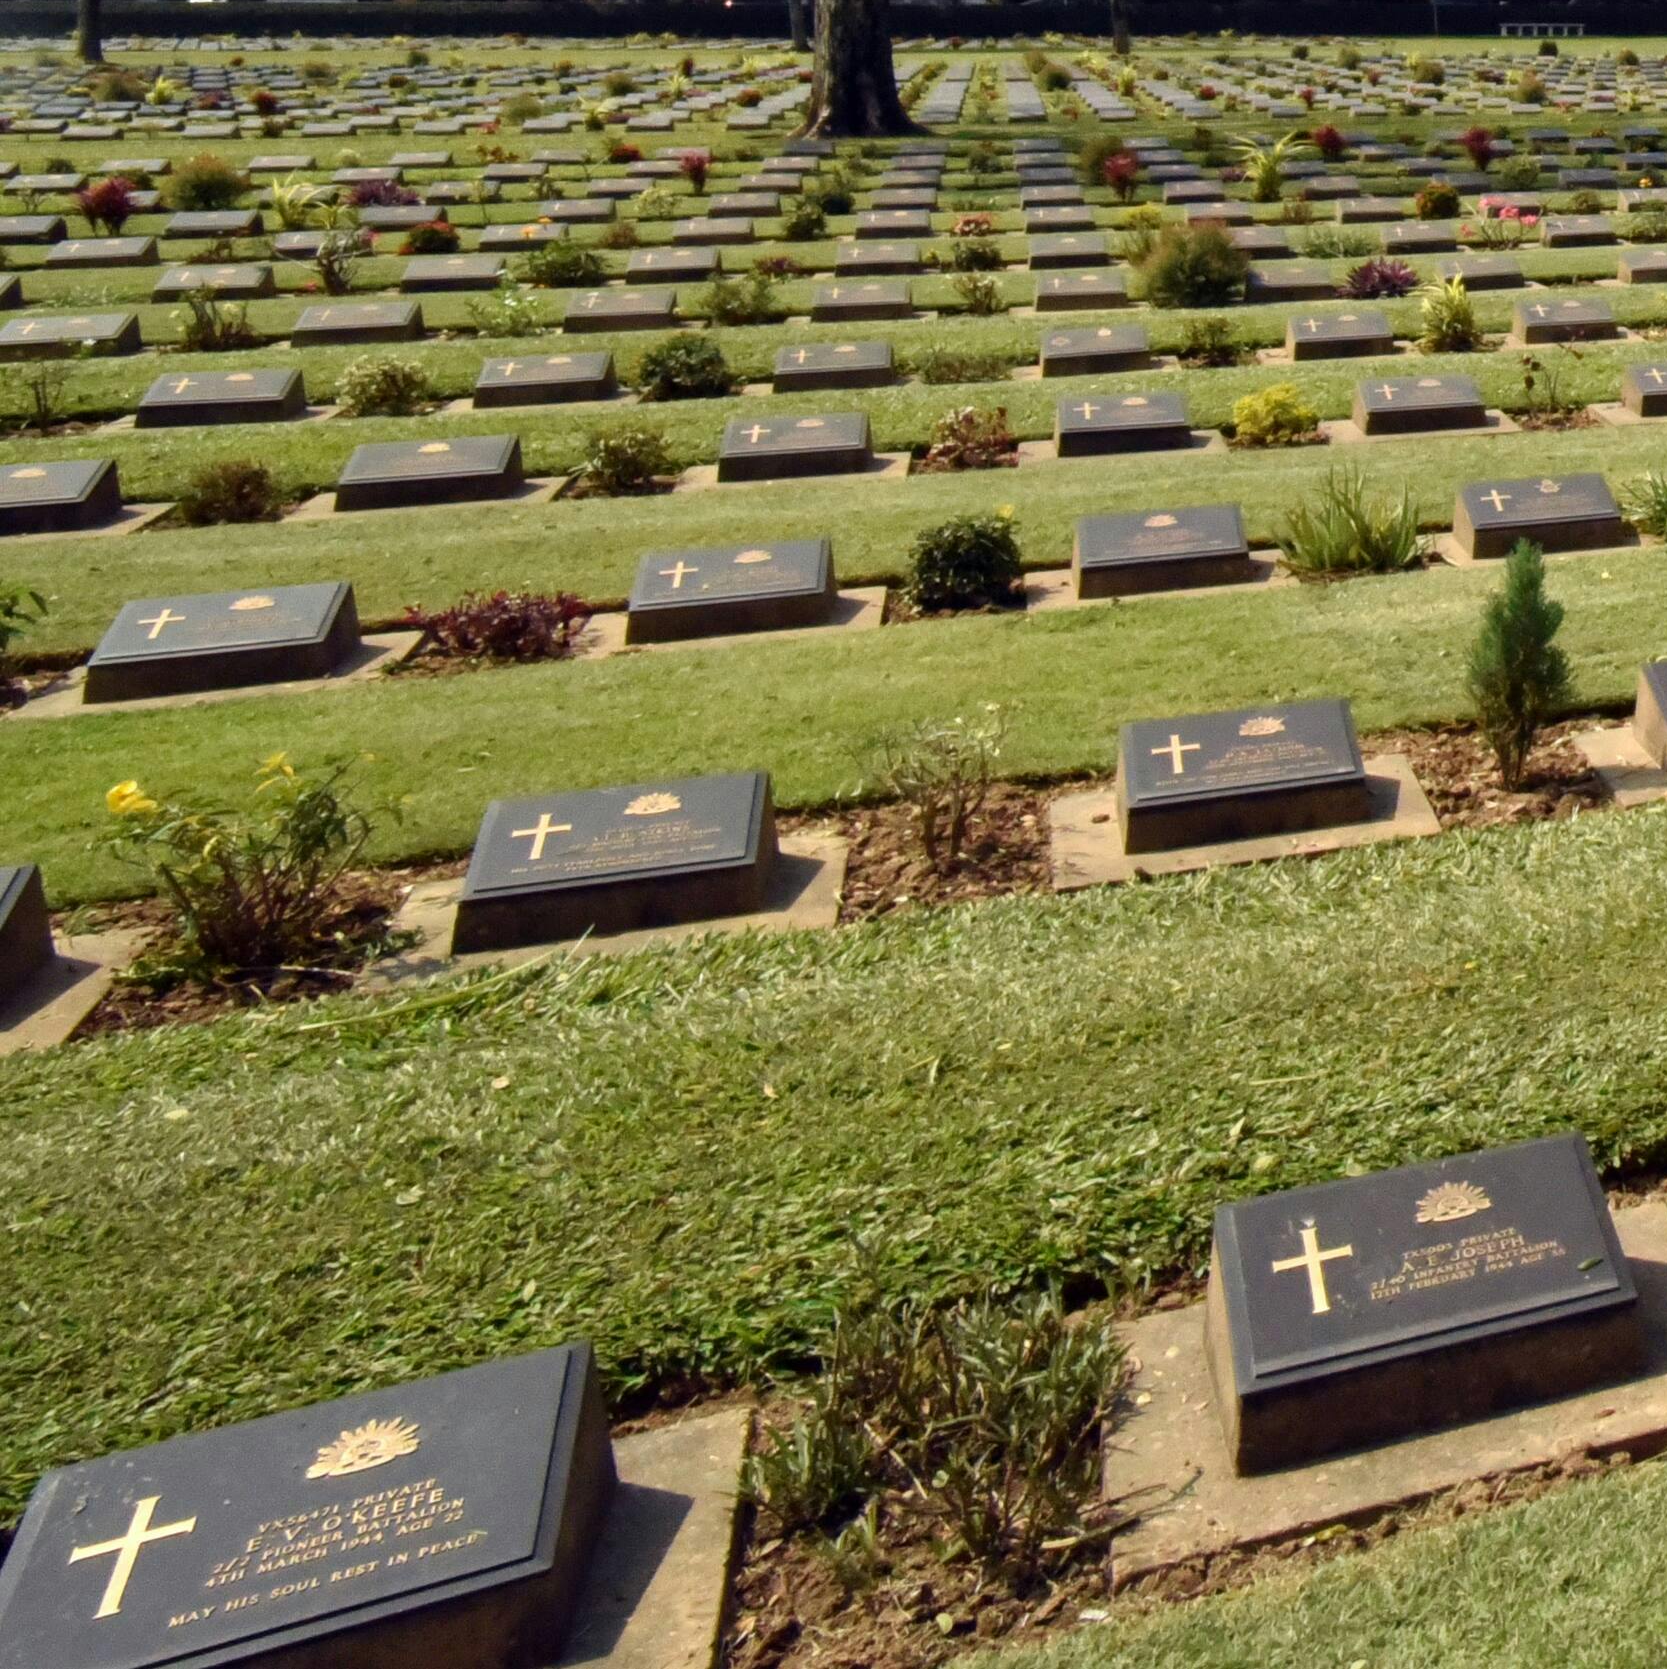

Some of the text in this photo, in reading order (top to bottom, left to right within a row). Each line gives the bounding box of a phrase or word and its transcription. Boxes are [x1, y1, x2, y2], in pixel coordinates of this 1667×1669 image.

[1450, 1234, 1526, 1262] JOSEPH
[1460, 1227, 1517, 1248] PRIVATE
[1408, 1267, 1476, 1291] FEBRUARY
[1520, 1252, 1543, 1265] AGE
[1413, 1258, 1478, 1281] INFANTRY
[1486, 1240, 1558, 1263] BATTALION
[351, 1477, 437, 1509] PRIVATE
[204, 1568, 247, 1588] 4TH
[256, 1546, 328, 1575] MARCH
[340, 1531, 384, 1552] 1944
[395, 1518, 435, 1536] AGE
[213, 1496, 465, 1574] 2/2 PIONEER BATTALION
[167, 1532, 479, 1629] MAY HIS SOUL REST IN PEACE
